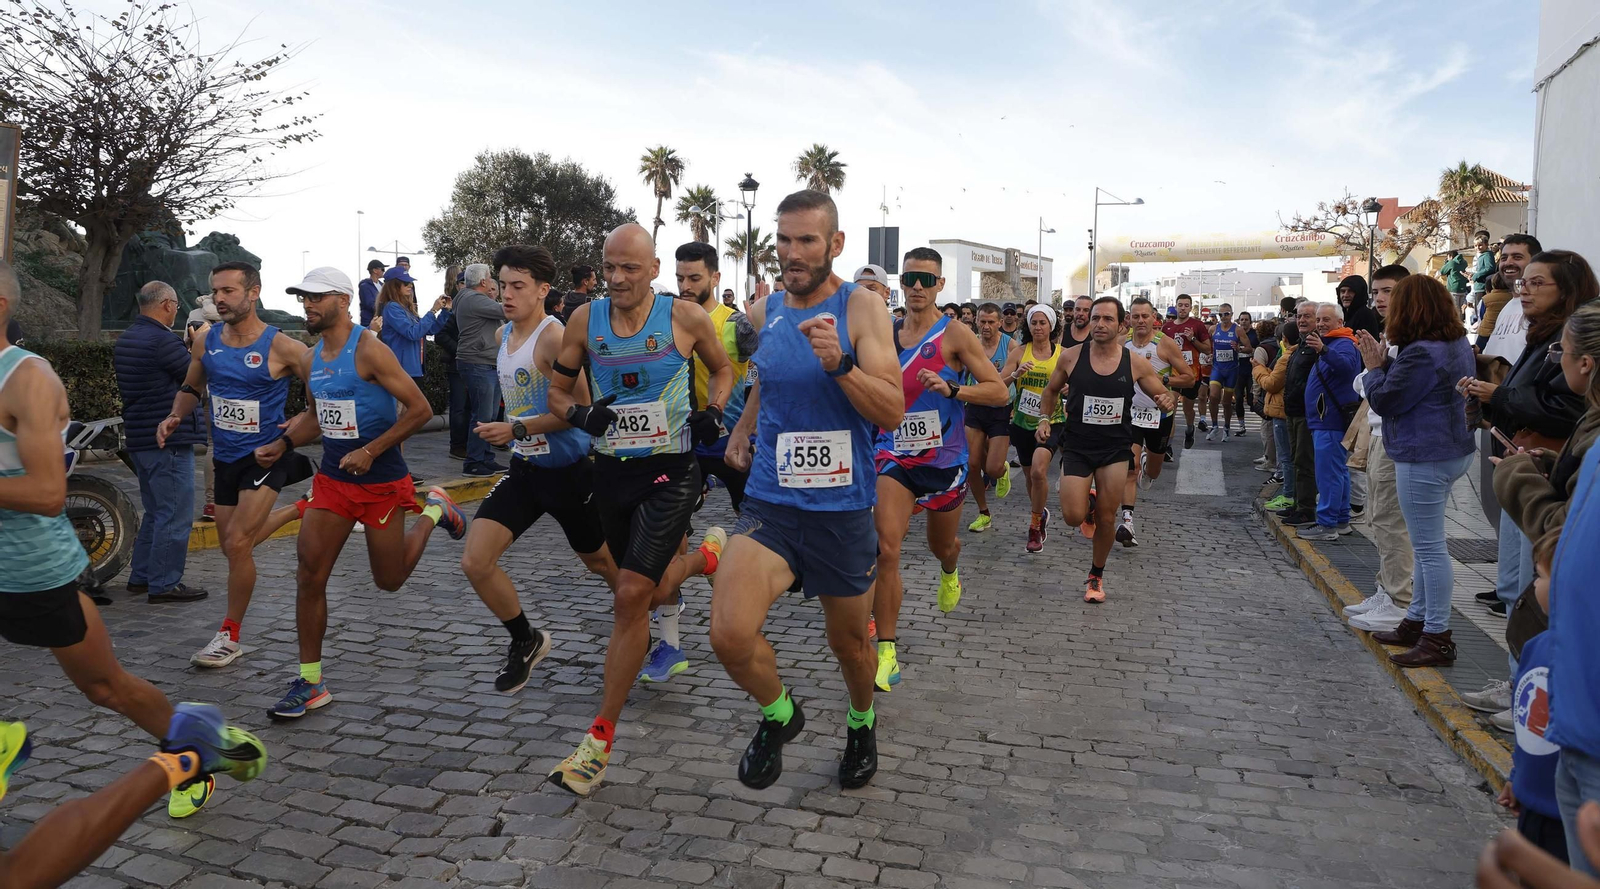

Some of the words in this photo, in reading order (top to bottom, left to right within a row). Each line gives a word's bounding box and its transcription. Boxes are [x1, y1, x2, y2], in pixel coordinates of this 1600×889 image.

[1130, 240, 1176, 248] Cruzcampo
[1275, 233, 1326, 243] Cruzcampo
[1186, 247, 1222, 255] DOBLEMENTE
[1223, 245, 1262, 254] REFRESCANTE
[1026, 397, 1041, 409] 404
[222, 405, 246, 421] 243
[1093, 404, 1114, 416] 592
[1136, 411, 1153, 421] 470
[322, 409, 343, 426] 252
[618, 414, 651, 432] 482
[902, 421, 927, 437] 198
[793, 436, 806, 444] XV
[793, 445, 832, 468] 558
